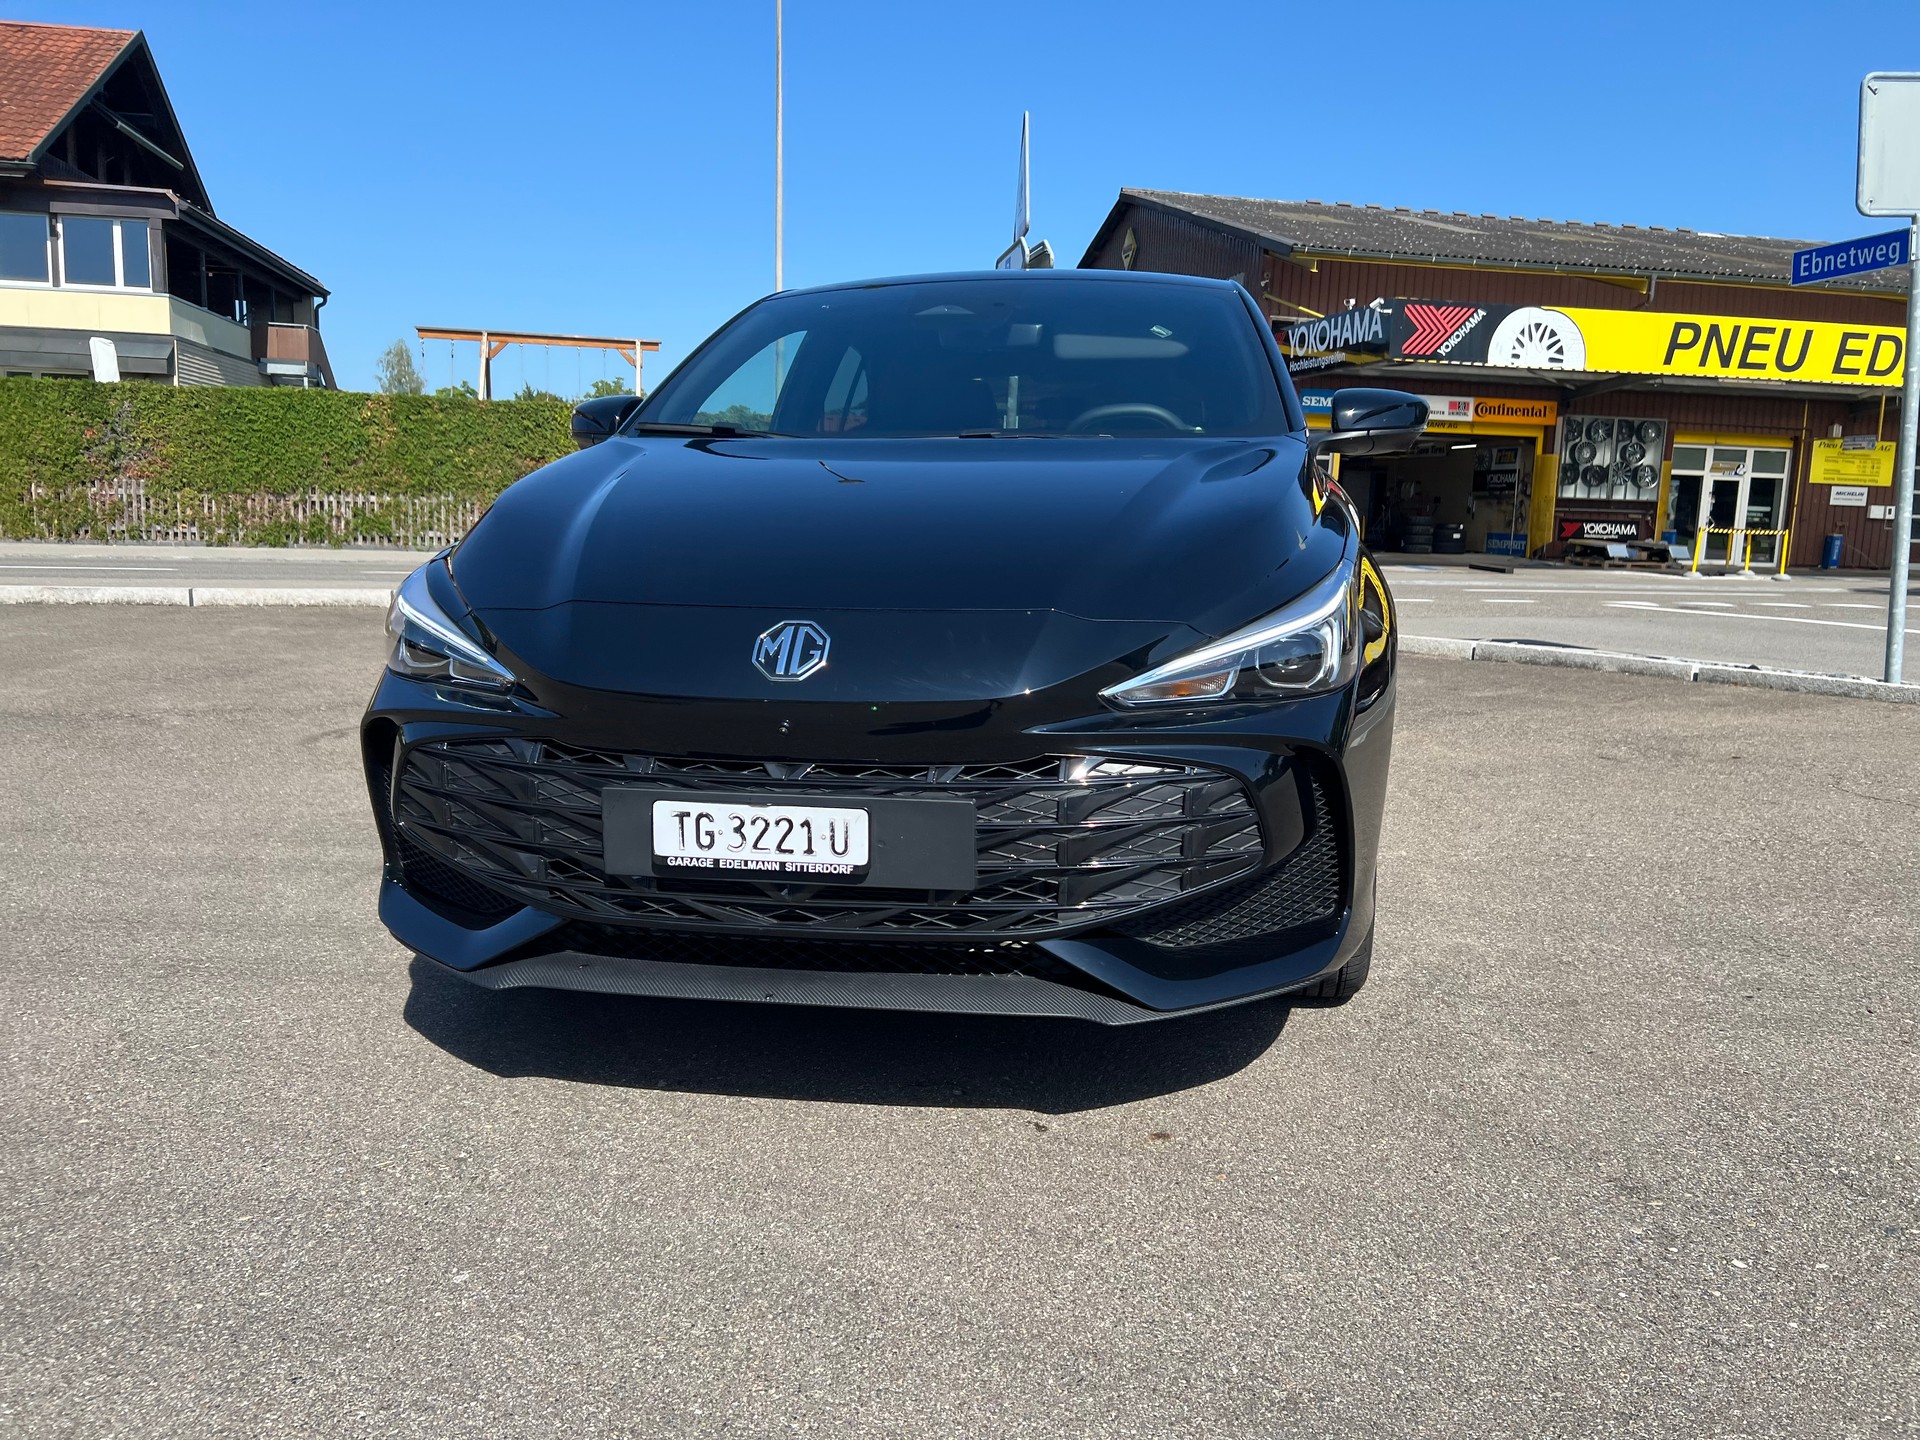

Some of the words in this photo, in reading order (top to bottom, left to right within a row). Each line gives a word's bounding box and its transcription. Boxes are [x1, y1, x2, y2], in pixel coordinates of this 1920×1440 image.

[1799, 239, 1900, 277] Ebnetweg
[1288, 308, 1383, 358] YOKOHAMA
[1436, 308, 1487, 356] YOKOHAMA
[1663, 321, 1814, 373] PNEU
[1831, 331, 1904, 377] ED
[1289, 352, 1346, 372] Hochleistungsreifen
[1474, 401, 1548, 418] Continental
[1583, 522, 1637, 536] YOKOHAMA
[759, 625, 824, 675] MG
[671, 810, 716, 852] TG
[726, 812, 817, 857] 3221
[828, 818, 850, 857] U
[667, 856, 714, 868] GARAGE
[719, 858, 780, 871] EDELMANN
[784, 861, 854, 875] SITTERDORF
